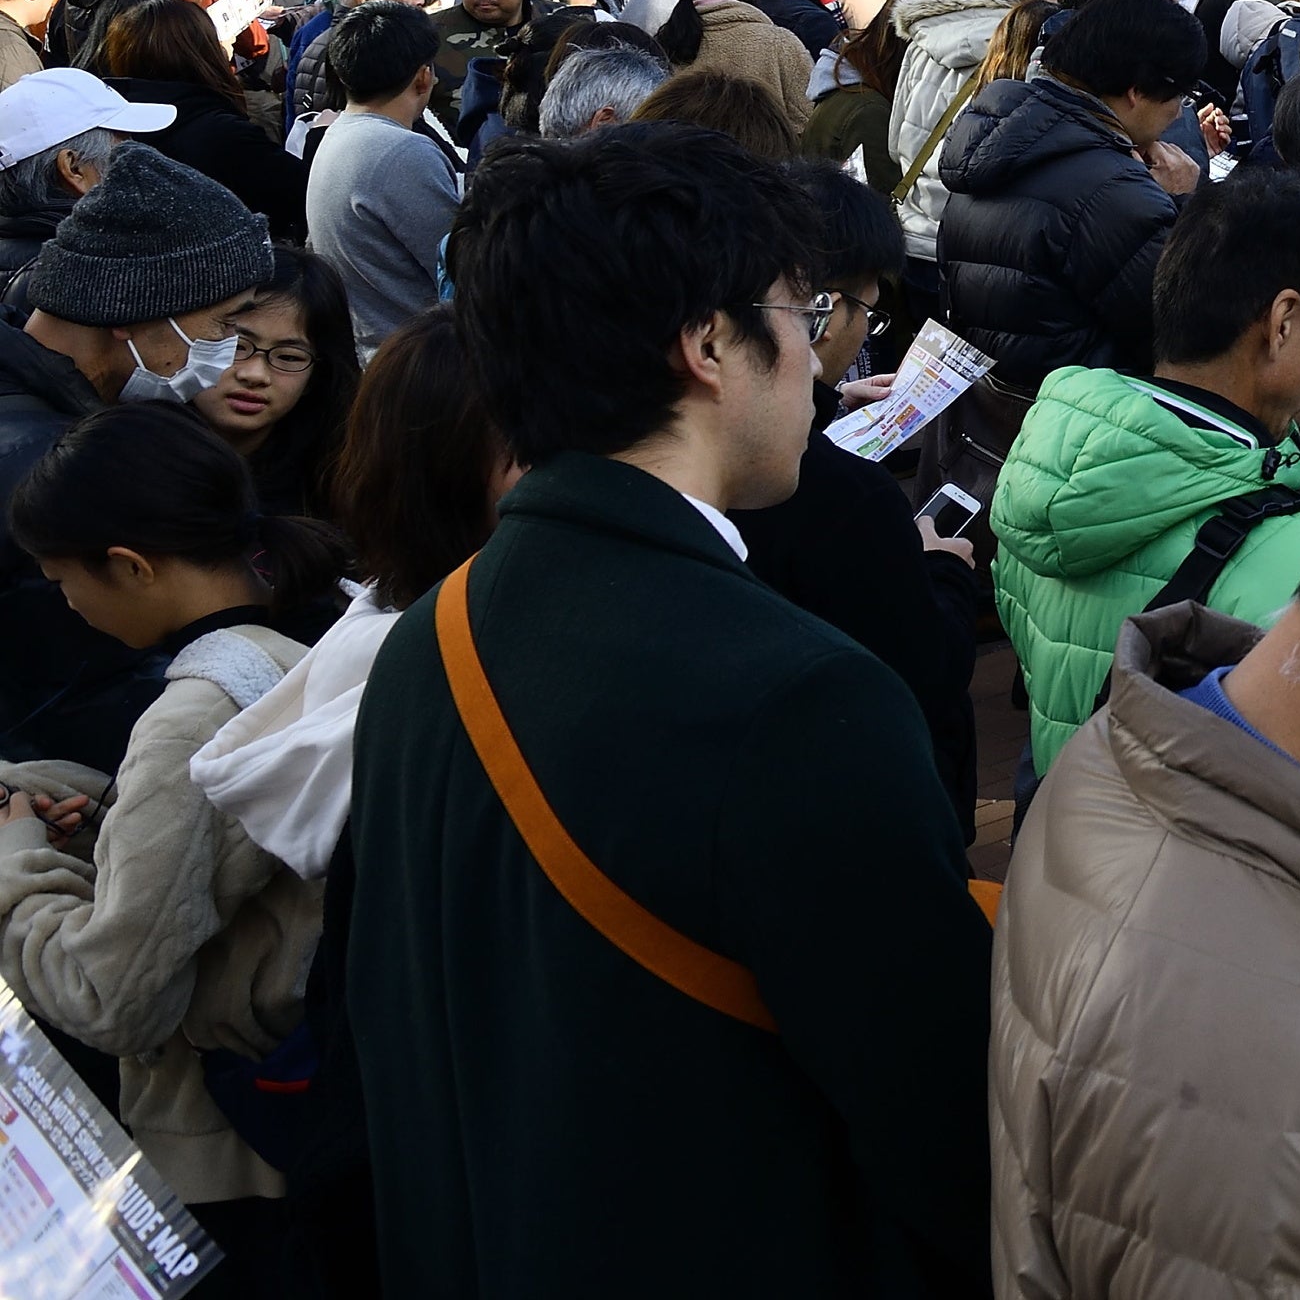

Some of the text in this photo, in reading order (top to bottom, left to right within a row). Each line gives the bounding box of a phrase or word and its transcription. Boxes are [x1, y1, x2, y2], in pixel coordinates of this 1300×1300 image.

[21, 1065, 58, 1106] OSAKA
[46, 1097, 82, 1136] MOTOR
[70, 1128, 105, 1165] SHOW
[115, 1174, 200, 1281] GUIDE MAP
